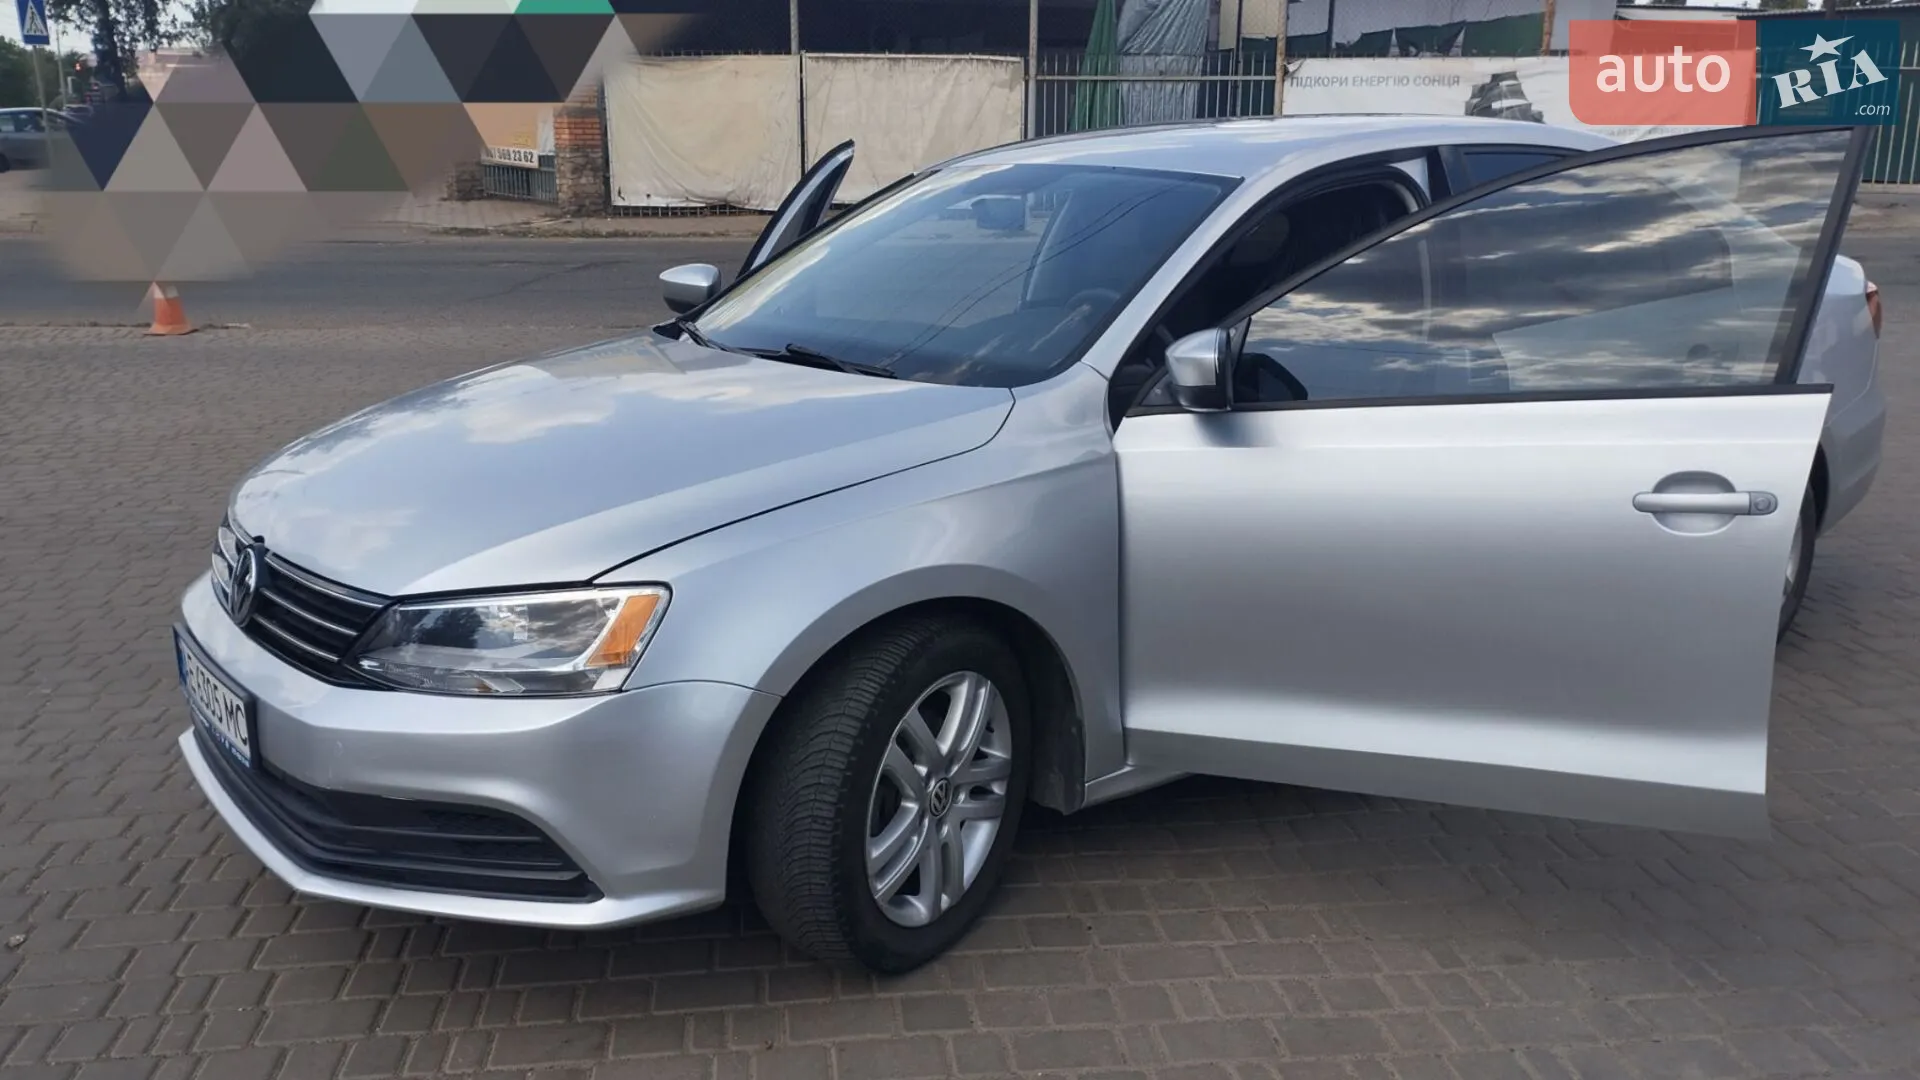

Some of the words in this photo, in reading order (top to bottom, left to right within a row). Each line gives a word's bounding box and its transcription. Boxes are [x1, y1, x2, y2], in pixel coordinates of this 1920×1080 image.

[1290, 75, 1348, 89] ПІДКОРИ
[1352, 75, 1410, 88] ЕНЕРГІЮ
[1413, 74, 1460, 88] СОНЦЯ
[512, 149, 522, 162] 23
[523, 150, 534, 163] 62
[196, 664, 223, 724] 6305
[222, 691, 248, 747] MC
